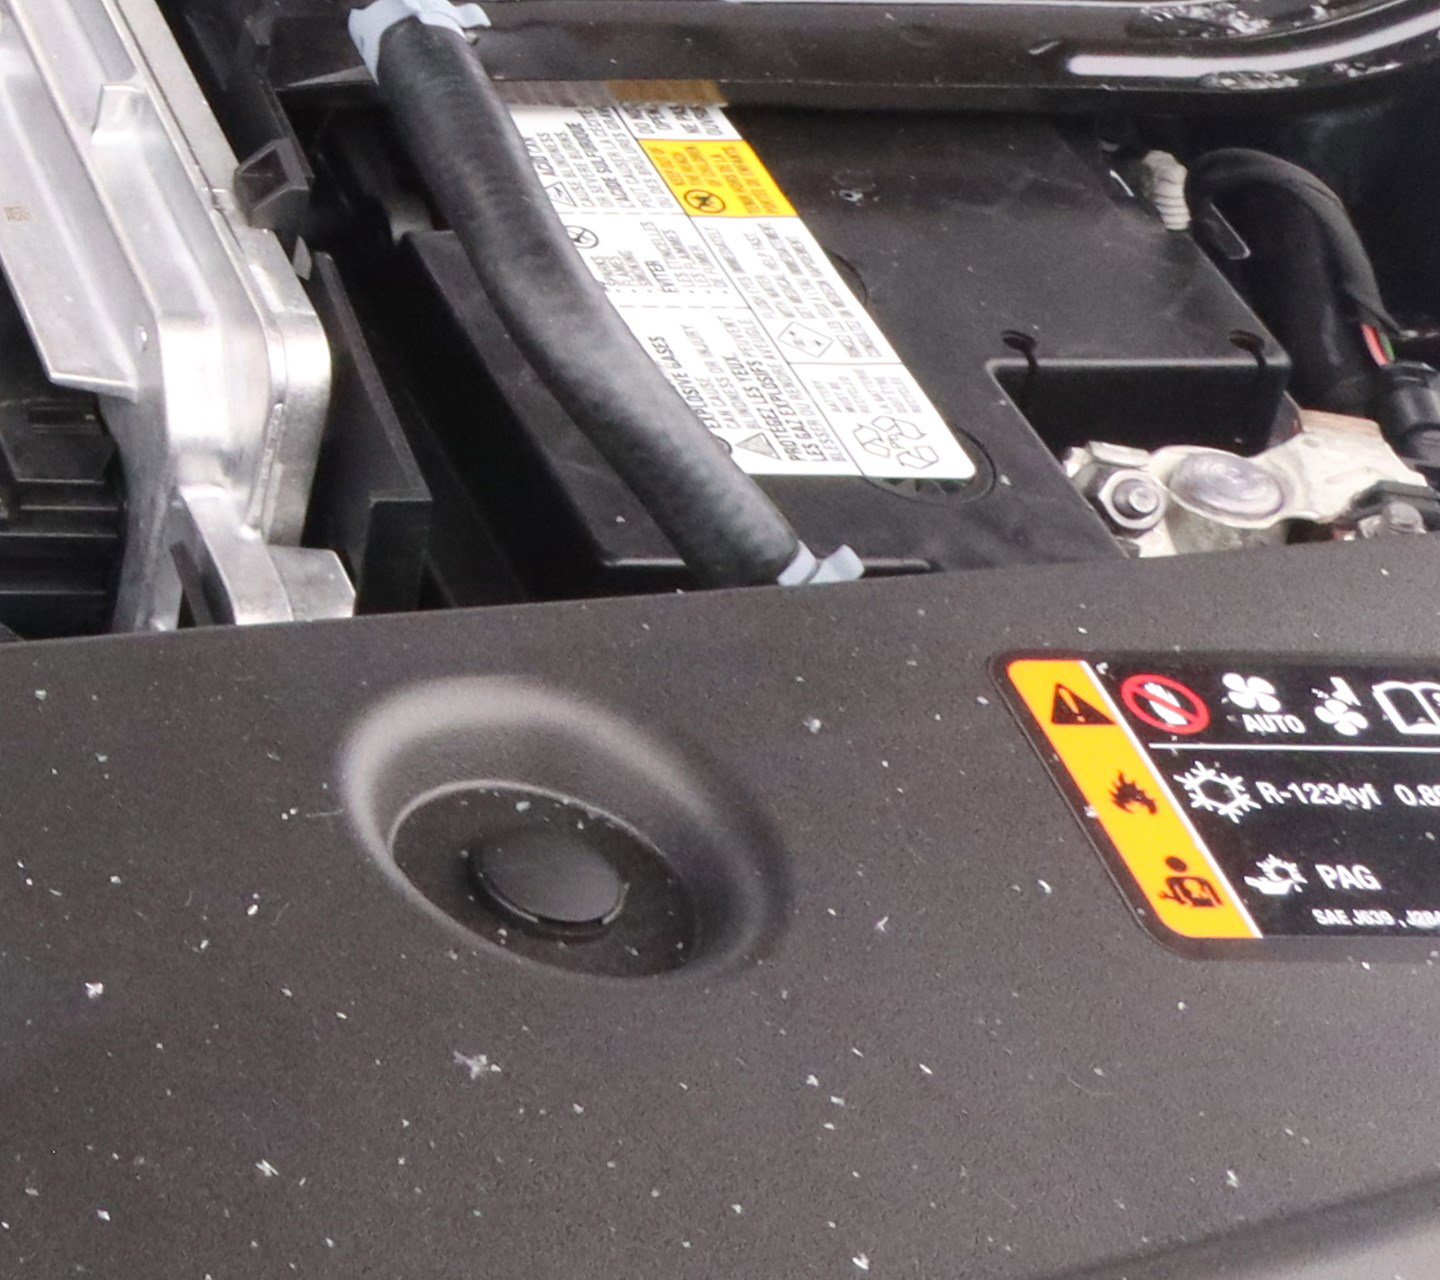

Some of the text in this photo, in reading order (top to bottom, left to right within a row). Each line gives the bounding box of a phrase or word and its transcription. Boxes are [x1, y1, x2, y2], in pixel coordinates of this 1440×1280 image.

[646, 336, 722, 428] EXPLOSIVE GASES
[703, 361, 724, 373] OR
[767, 363, 804, 399] RENDRE
[694, 377, 742, 428] CAN CAUSE
[714, 377, 762, 428] BLINDNESS
[716, 316, 827, 460] LES GAZ EXPLOSIFS PEUVENT
[742, 386, 768, 403] LES
[805, 420, 846, 461] BLESSER
[1242, 713, 1307, 735] AUTO
[1255, 781, 1382, 810] R-1234yf
[1314, 863, 1382, 891] PAG
[1311, 908, 1353, 927] SAE
